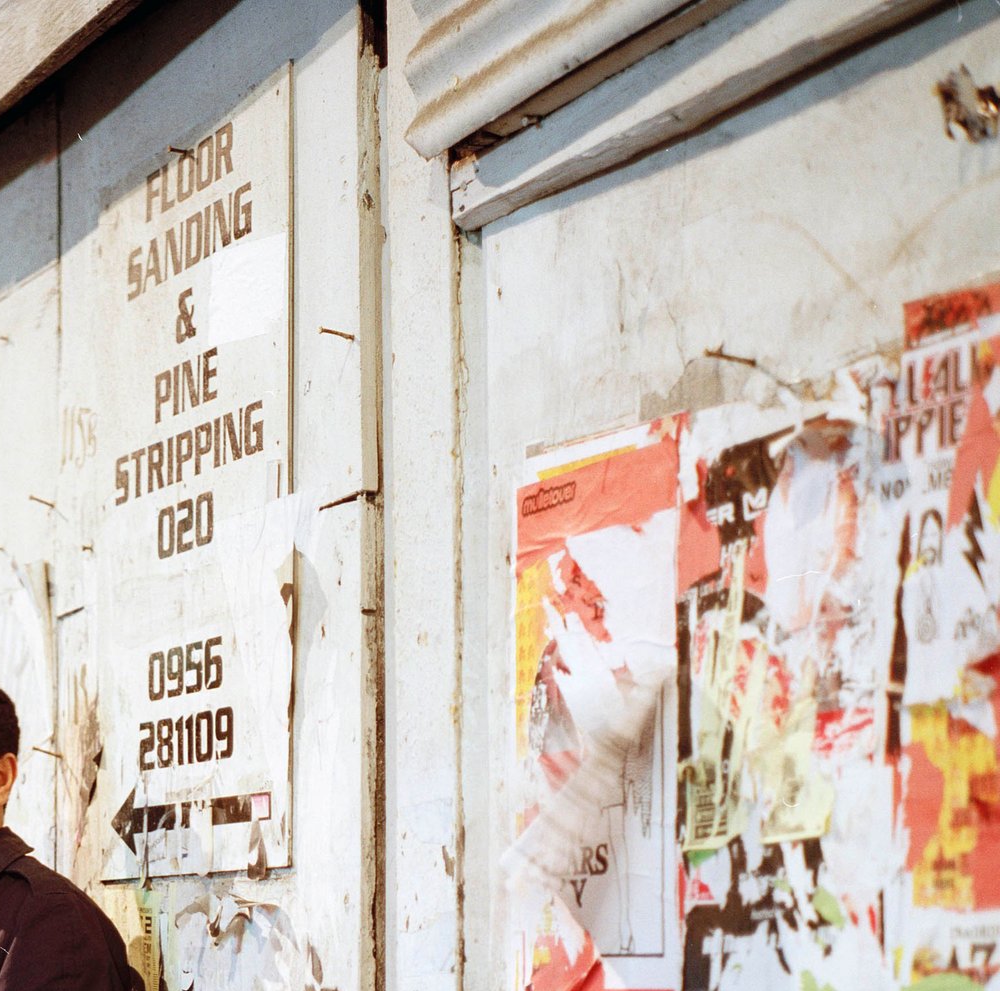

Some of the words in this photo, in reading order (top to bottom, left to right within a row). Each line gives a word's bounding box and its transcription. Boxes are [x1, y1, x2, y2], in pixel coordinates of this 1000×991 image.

[146, 122, 233, 223] FLOOR
[128, 181, 252, 302] SANDING
[176, 287, 196, 344] &
[154, 347, 218, 424] PINE
[115, 400, 264, 506] STRIPPING
[158, 491, 213, 559] 020
[148, 636, 222, 702] 0956
[139, 706, 234, 772] 281109
